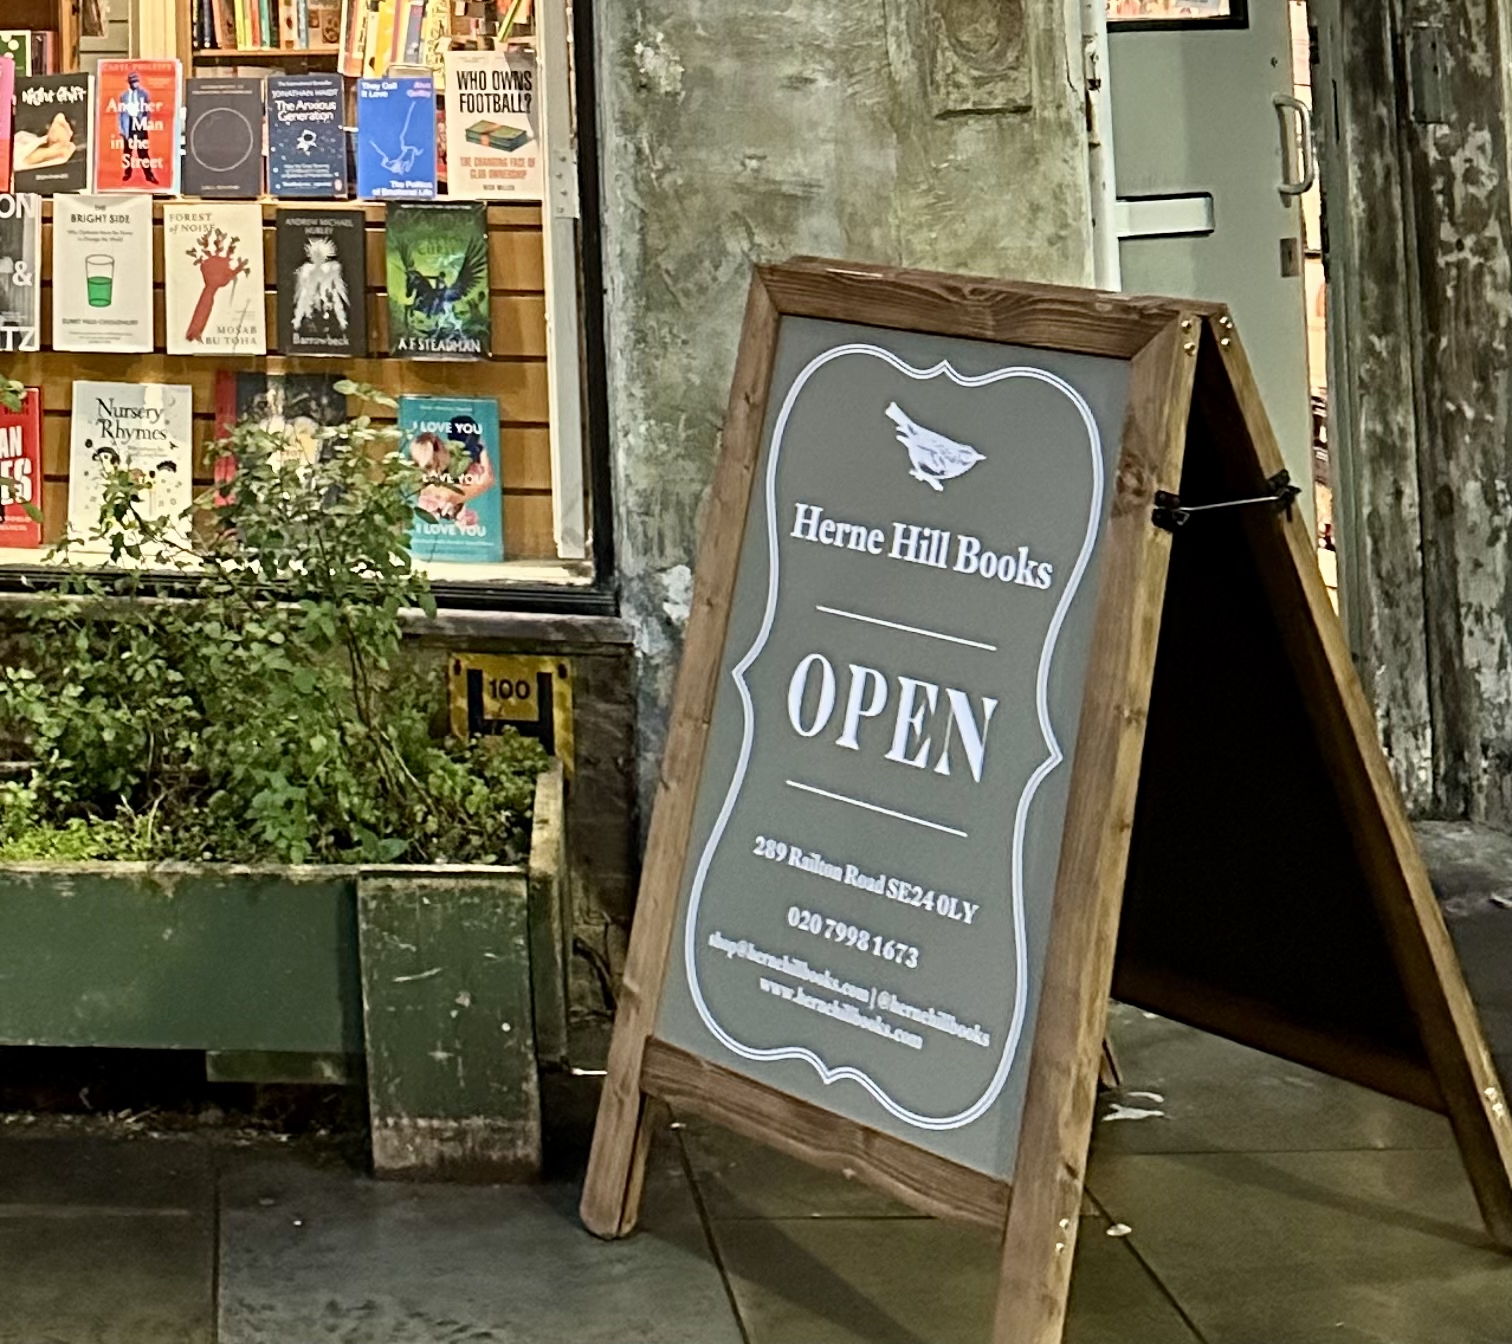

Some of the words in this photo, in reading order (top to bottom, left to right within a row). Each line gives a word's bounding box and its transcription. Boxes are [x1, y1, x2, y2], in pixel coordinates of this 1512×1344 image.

[361, 81, 381, 91] They
[381, 81, 398, 90] Call
[456, 70, 487, 91] WHO
[491, 70, 533, 92] OWNS
[368, 90, 389, 99] Love
[274, 100, 295, 112] The
[459, 93, 533, 114] FOOTBALL?
[277, 110, 335, 122] Generation
[131, 118, 164, 131] Man
[110, 135, 124, 150] in
[128, 134, 150, 150] the
[121, 153, 164, 169] Street
[94, 204, 107, 212] THE
[70, 213, 107, 224] BRIGHT
[109, 213, 130, 224] SIDE
[168, 212, 213, 222] FOREST
[285, 218, 319, 227] ANDREW
[319, 218, 355, 228] MICHAEL
[168, 224, 178, 235] of
[304, 227, 333, 236] HURLEY
[11, 260, 33, 287] &
[216, 325, 258, 335] MOSAB
[224, 336, 258, 346] TOHA
[292, 333, 350, 346] Barrowbeck
[417, 337, 482, 353] STEADMAN
[94, 396, 164, 424] Nursery
[94, 418, 168, 445] Rhymes
[420, 421, 453, 434] LOVE
[454, 422, 483, 435] YOU
[423, 523, 456, 535] LOVE
[458, 524, 486, 537] YOU
[790, 501, 885, 555] Herne
[888, 521, 951, 569] Hill
[952, 534, 1054, 590] Books
[488, 678, 531, 700] 100
[787, 652, 999, 784] OPEN
[752, 835, 788, 862] 289
[787, 845, 843, 882] Railton
[843, 863, 887, 895] Road
[885, 877, 937, 911] SE24
[787, 905, 823, 935] 020
[824, 918, 871, 952] 7998
[871, 935, 920, 969] 1673
